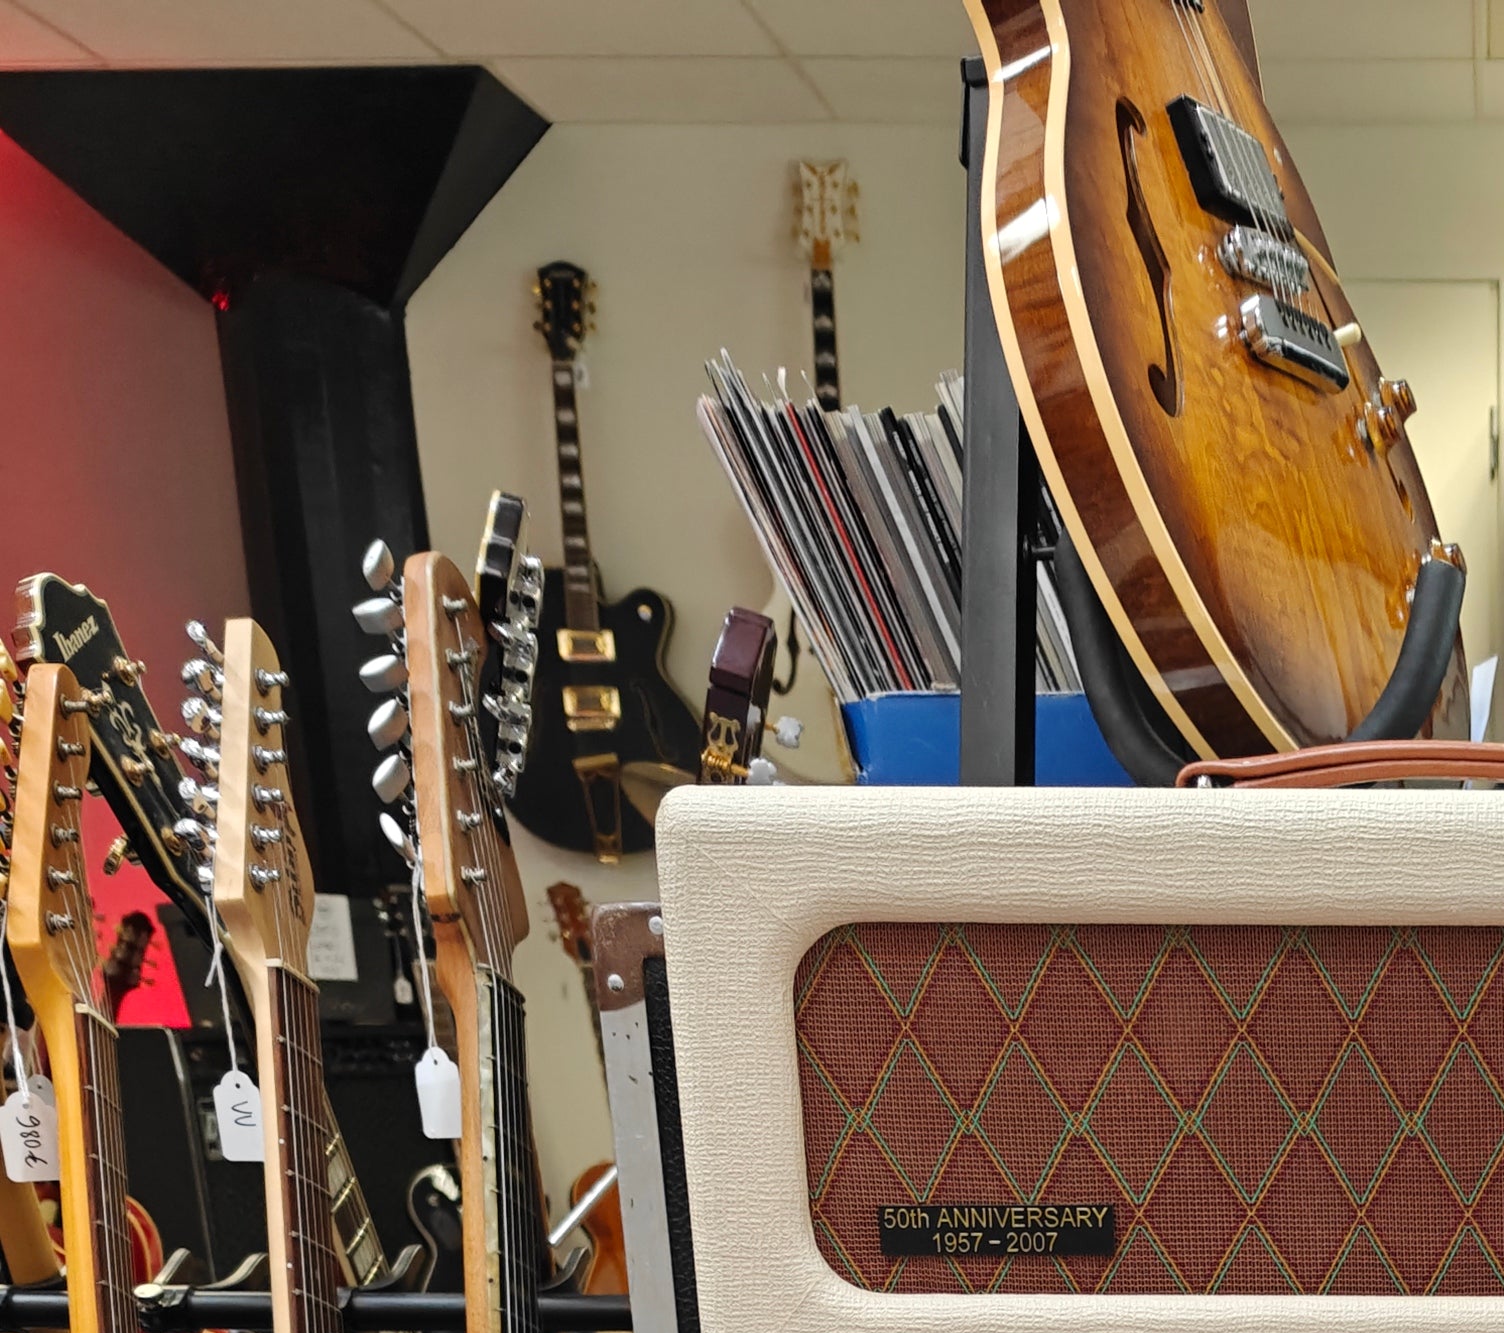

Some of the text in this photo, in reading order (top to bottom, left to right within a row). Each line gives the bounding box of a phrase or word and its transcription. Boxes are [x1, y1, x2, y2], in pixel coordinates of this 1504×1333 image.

[52, 614, 100, 663] Ibanez
[883, 1206, 1109, 1229] 50th ANNIVERSARY
[932, 1231, 984, 1253] 1957
[1006, 1231, 1059, 1253] 2007
